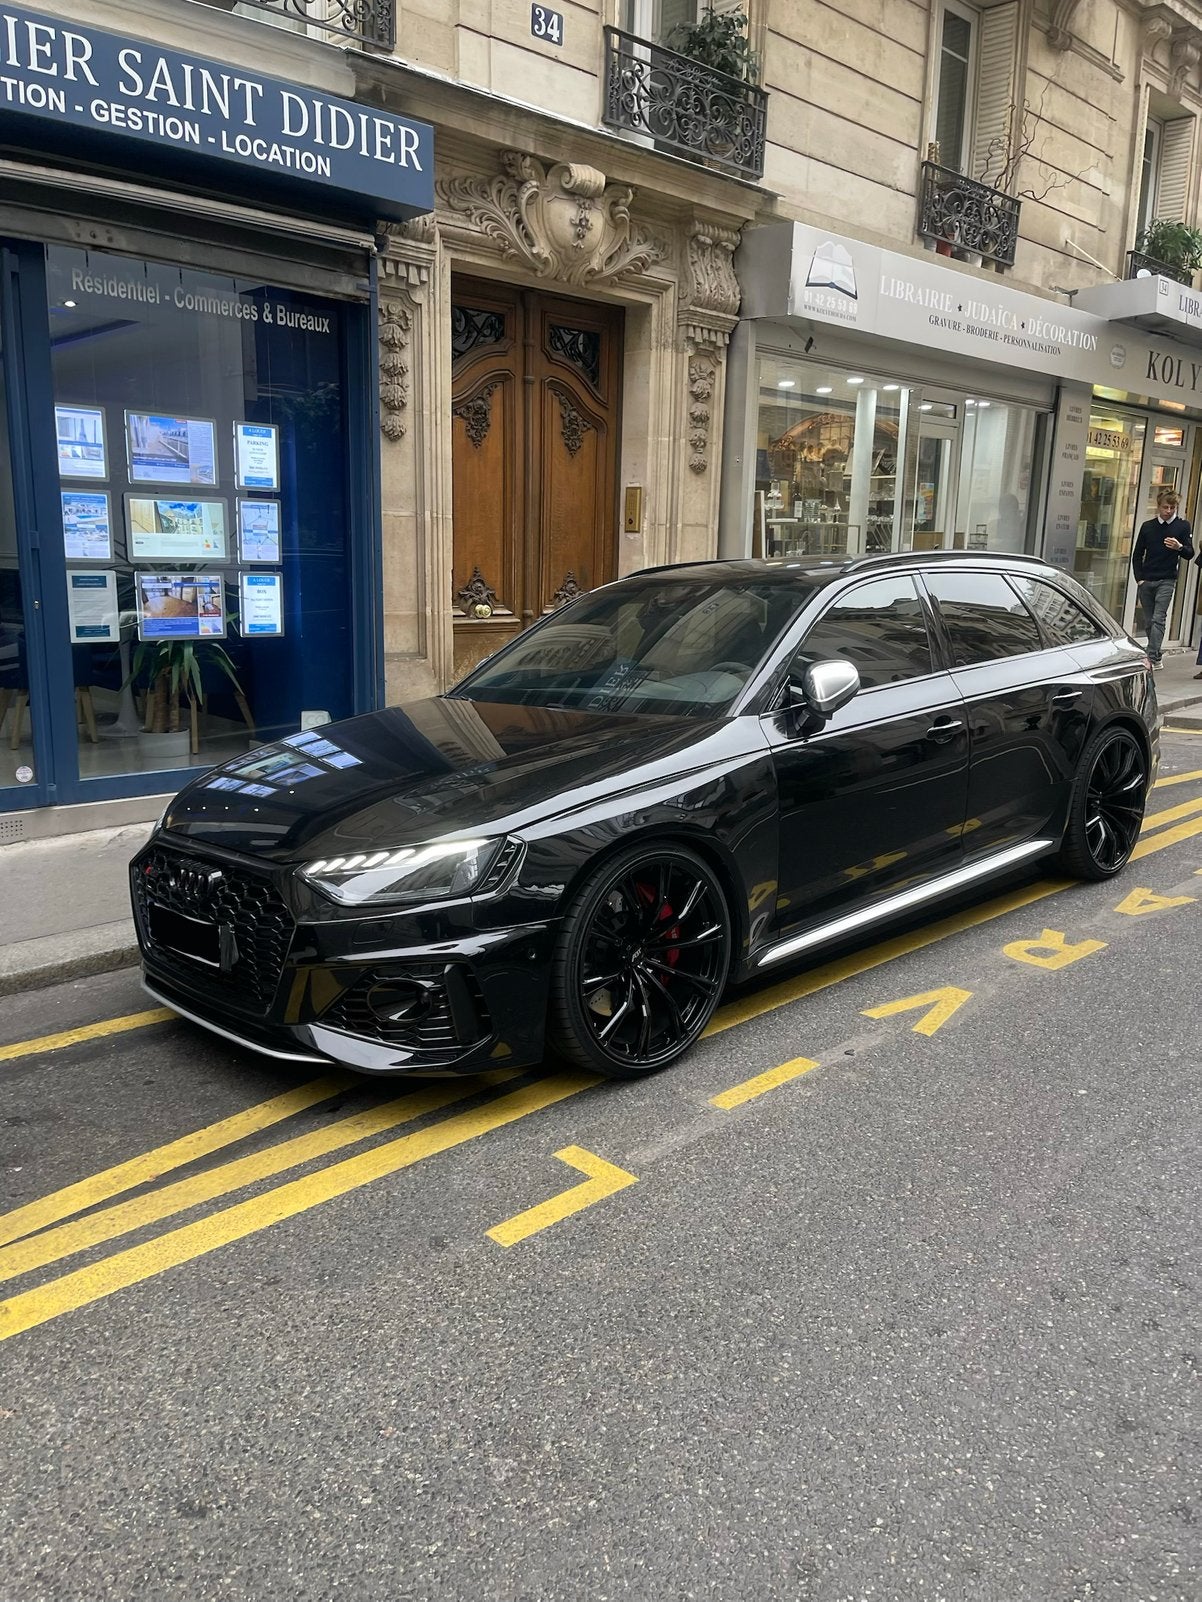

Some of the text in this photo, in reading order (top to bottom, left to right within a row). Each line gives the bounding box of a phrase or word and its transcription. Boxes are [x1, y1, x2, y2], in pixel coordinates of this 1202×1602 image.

[534, 7, 560, 42] 34
[0, 14, 423, 172] IER SAINT DIDIER
[0, 76, 66, 113] TION
[90, 99, 200, 145] GESTION
[222, 130, 331, 178] LOCATION
[71, 267, 160, 304] Résidentiel
[174, 287, 258, 321] Commerces
[263, 302, 273, 324] &
[277, 304, 330, 334] Bureaux
[880, 275, 1098, 351] LIBRAIRIE JUDAÏCA DÉCORATION
[1161, 282, 1168, 293] 34
[928, 314, 962, 332] GRAVURE
[966, 324, 999, 341] BRODERIE
[1003, 333, 1061, 356] PERSONNALISATION
[247, 440, 269, 448] PARKING
[1094, 432, 1102, 445] 42
[1103, 433, 1111, 447] 25
[1112, 435, 1120, 448] 53
[1120, 437, 1129, 449] 69
[484, 862, 1202, 1248] LIVRA
